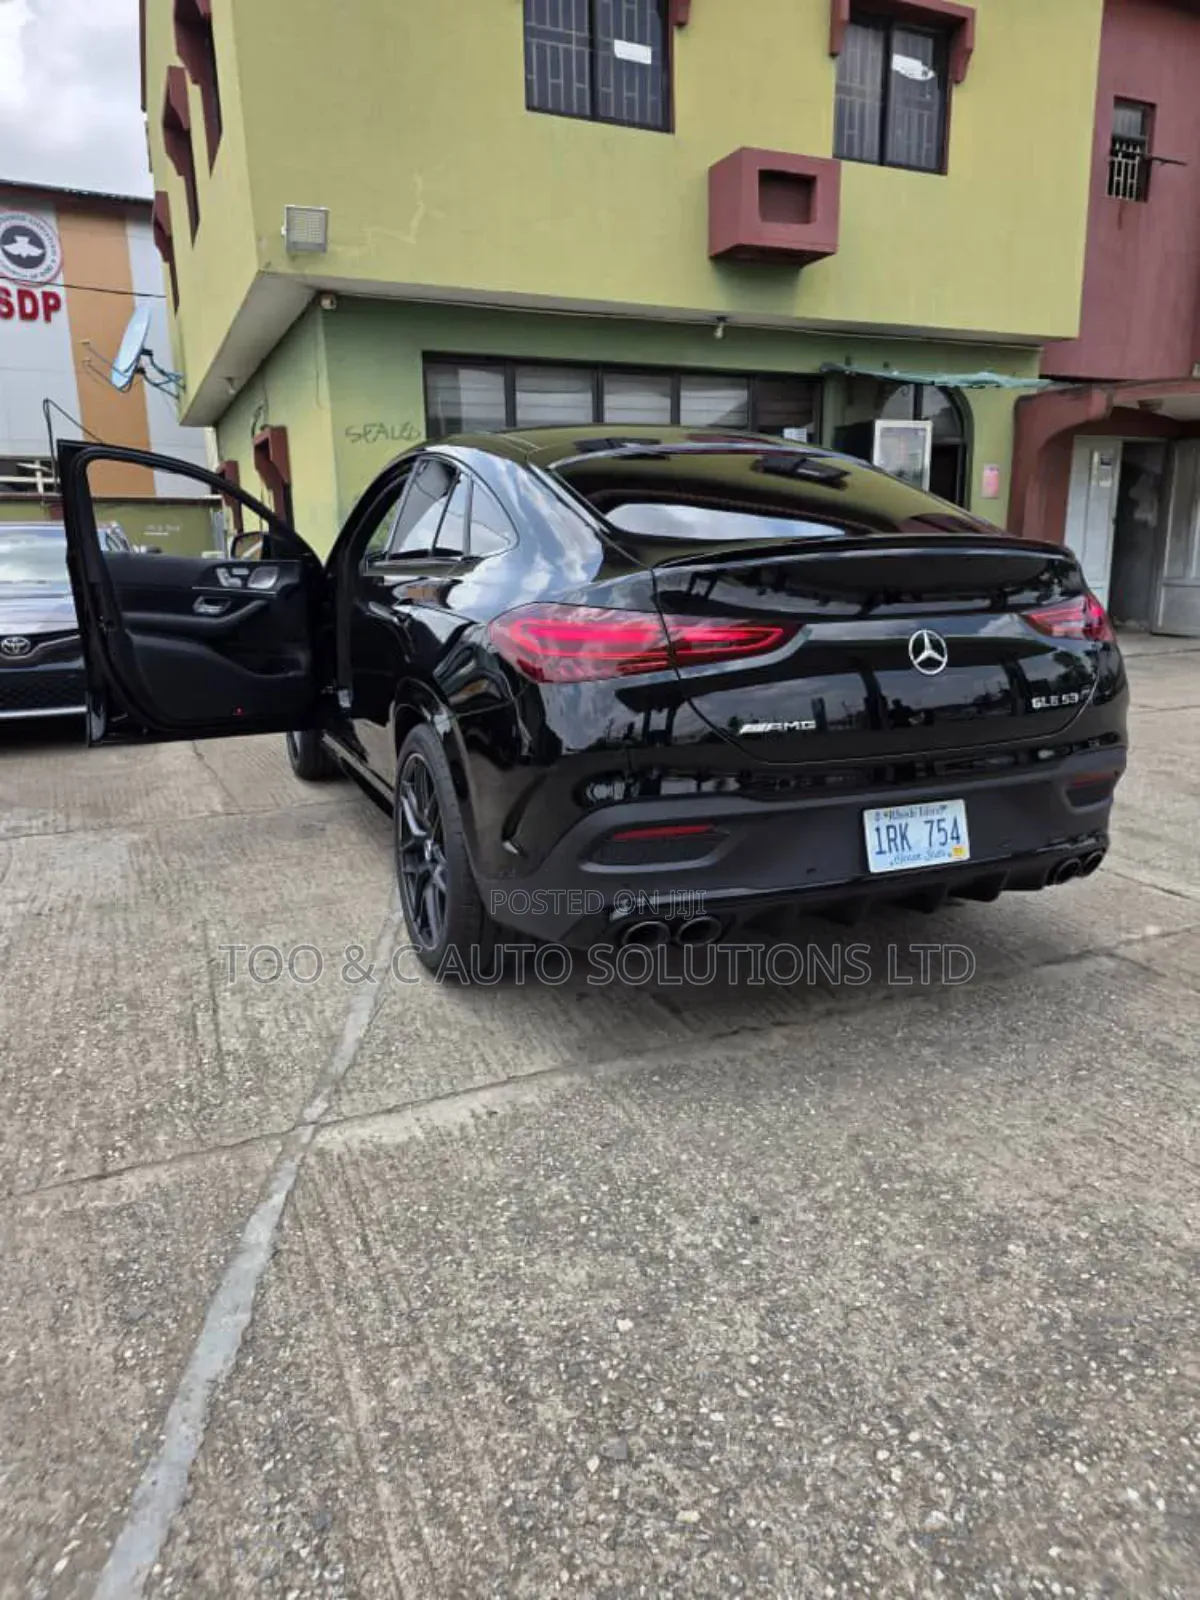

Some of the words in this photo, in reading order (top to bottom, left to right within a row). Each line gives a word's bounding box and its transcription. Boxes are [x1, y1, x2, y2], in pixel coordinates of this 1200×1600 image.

[1031, 695, 1059, 709] GLE
[875, 821, 912, 855] 1RK
[923, 815, 961, 849] 754
